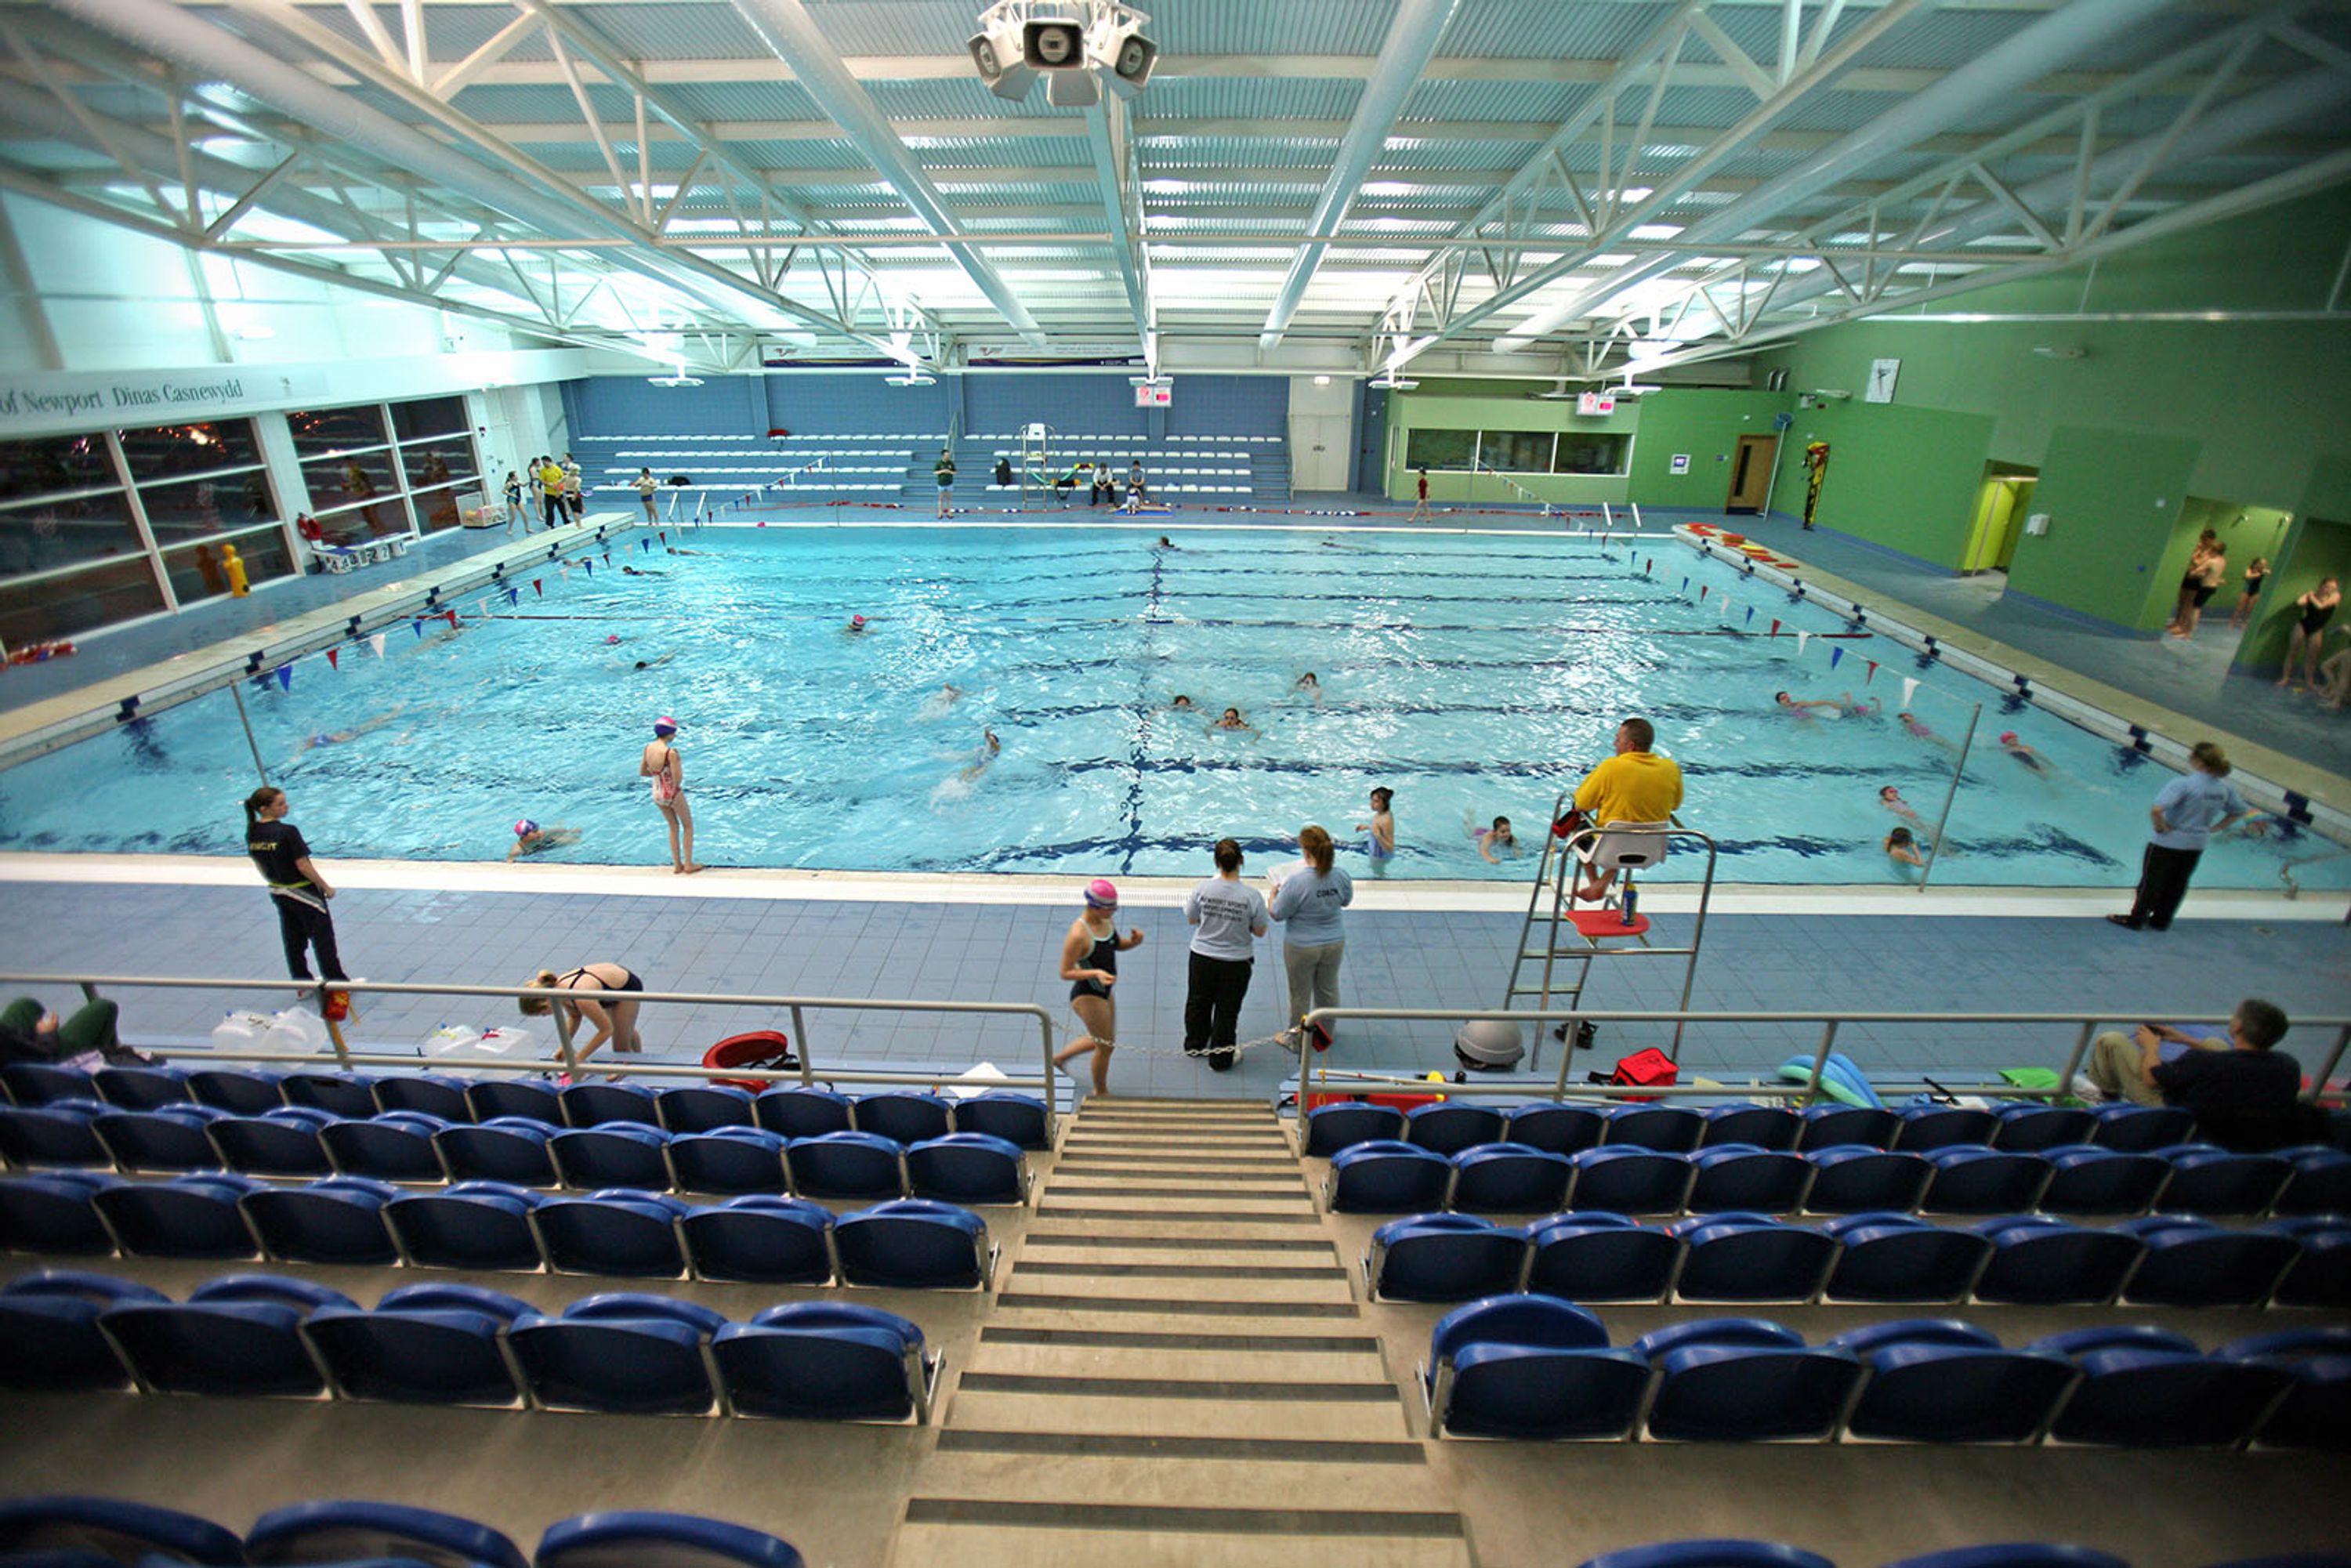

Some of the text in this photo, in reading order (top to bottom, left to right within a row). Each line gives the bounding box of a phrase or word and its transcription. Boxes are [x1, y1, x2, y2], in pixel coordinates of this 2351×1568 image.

[22, 390, 103, 416] Newport
[113, 387, 161, 407] Dinas
[162, 378, 244, 404] Casnewydd
